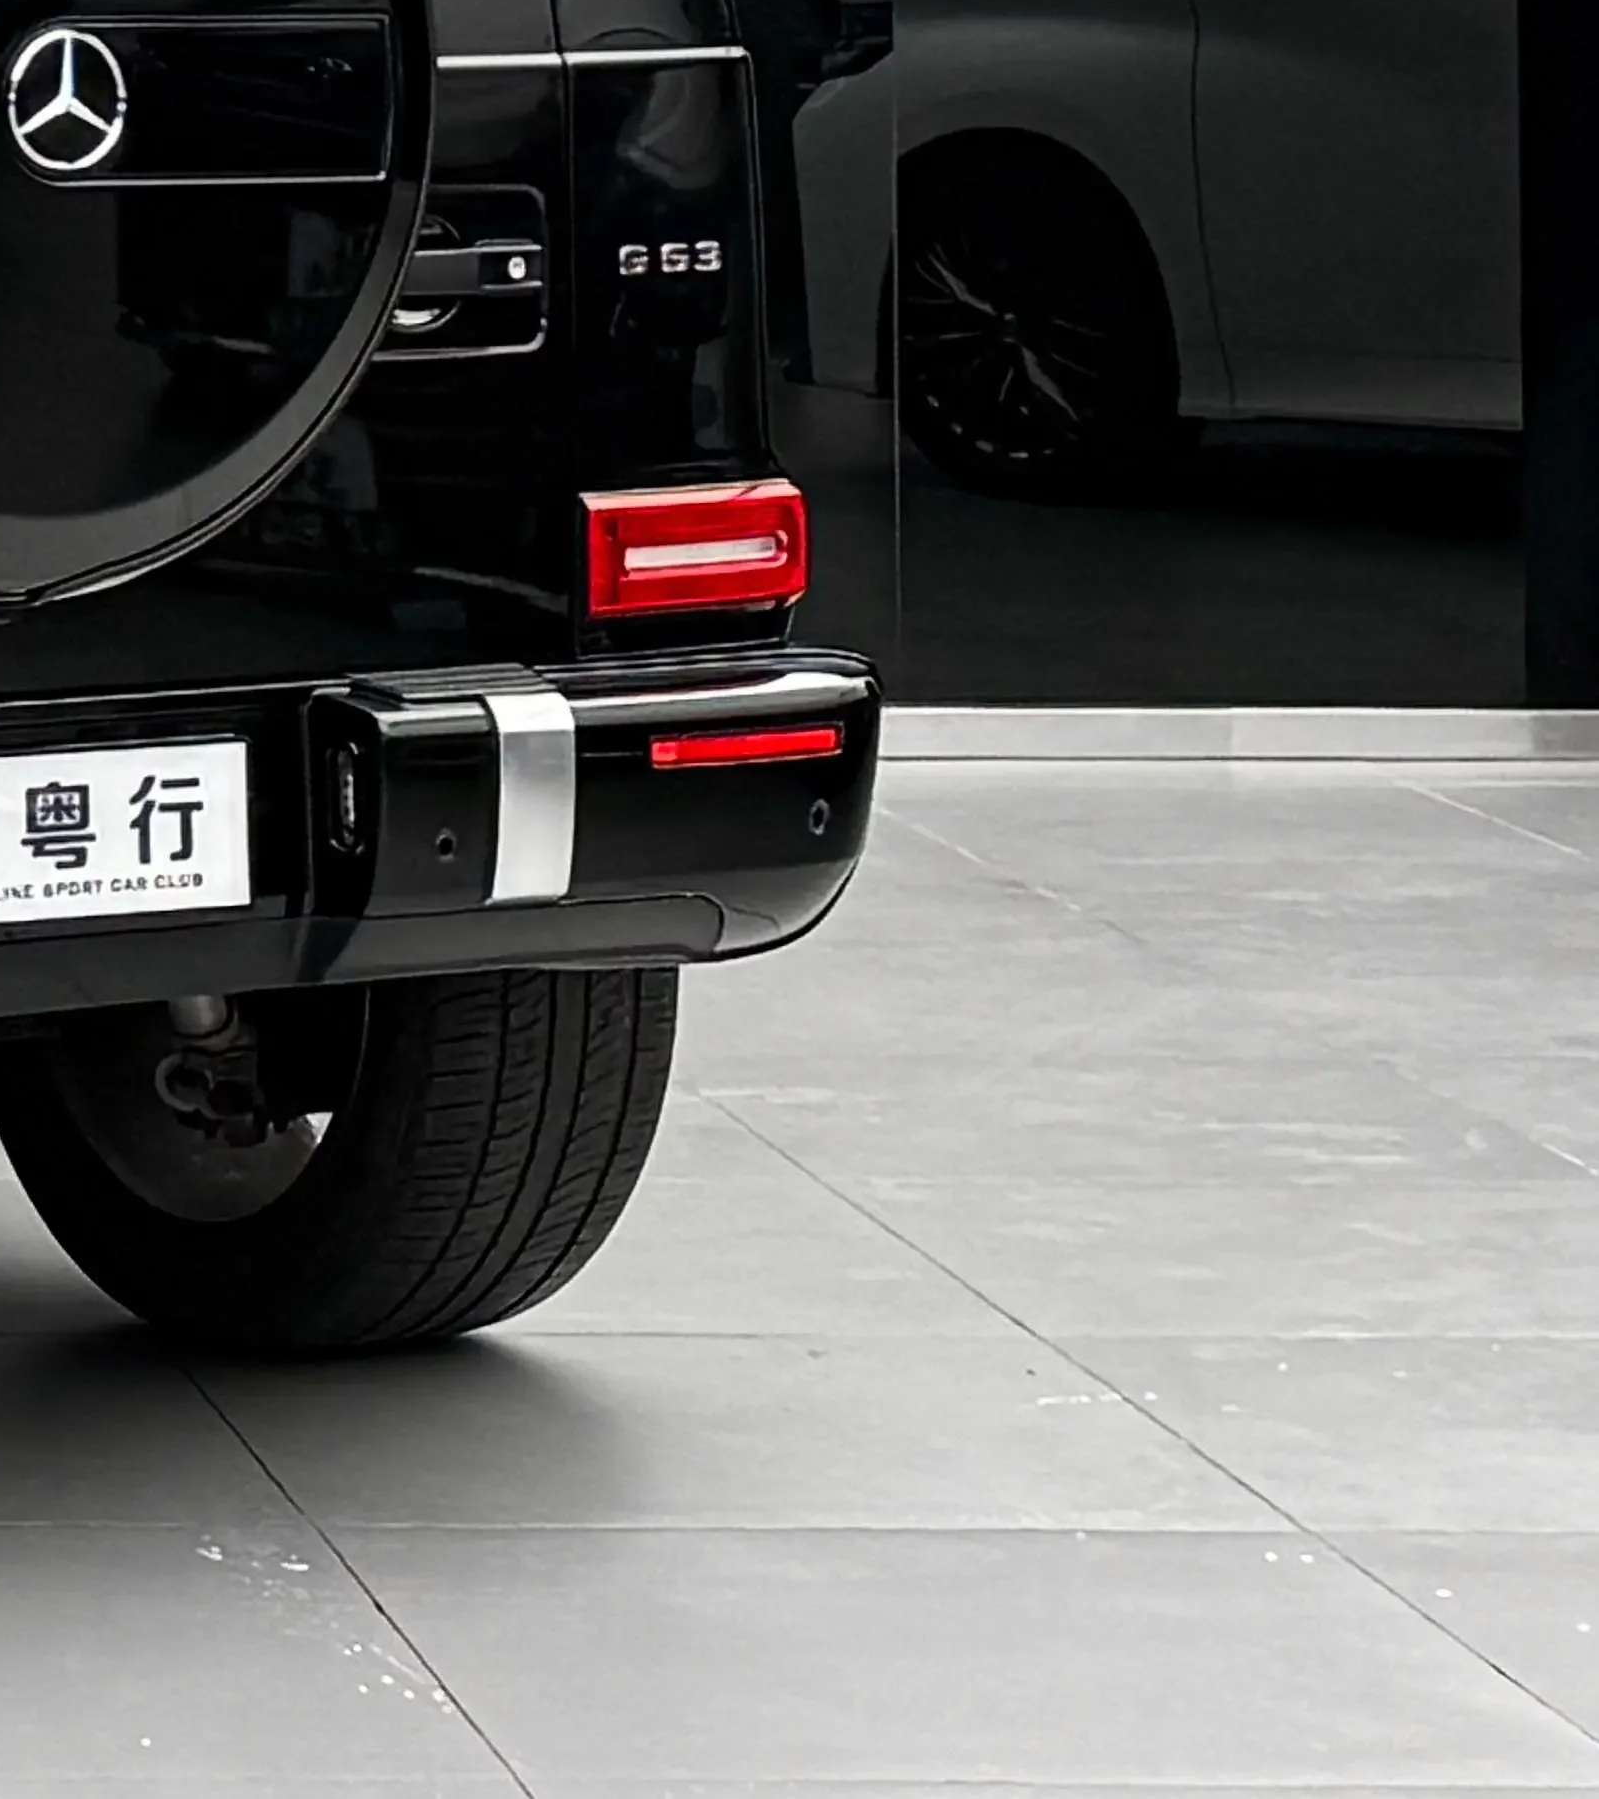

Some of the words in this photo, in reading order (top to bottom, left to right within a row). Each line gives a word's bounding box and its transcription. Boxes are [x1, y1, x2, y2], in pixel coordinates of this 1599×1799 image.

[619, 243, 649, 275] G
[660, 240, 722, 273] 63
[42, 879, 103, 898] SPORT
[110, 876, 148, 893] CAR
[154, 872, 204, 890] CLUB
